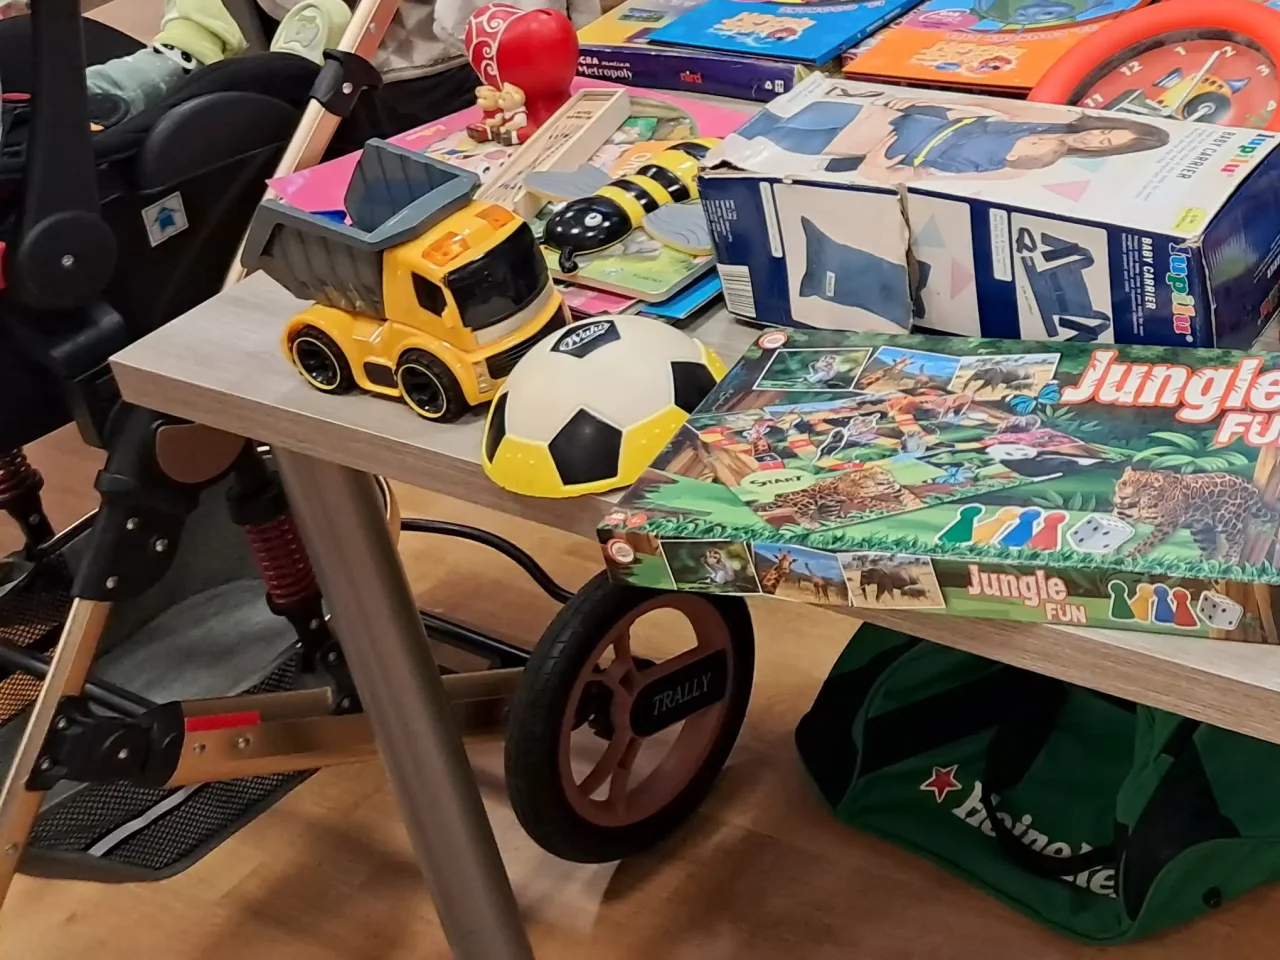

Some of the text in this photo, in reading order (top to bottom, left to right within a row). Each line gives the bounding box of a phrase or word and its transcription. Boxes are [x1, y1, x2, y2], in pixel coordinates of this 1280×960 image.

[577, 55, 599, 66] GRA
[1174, 46, 1187, 56] 1
[1221, 45, 1237, 58] 2
[577, 65, 632, 80] Metropoly
[1120, 61, 1143, 77] 12
[1256, 64, 1270, 77] 3
[1084, 93, 1104, 108] 11
[1175, 146, 1215, 180] CARRIER
[1220, 132, 1276, 176] lupilu
[1141, 237, 1157, 310] BABY CARRIER
[1166, 242, 1195, 335] lupilu
[966, 564, 1069, 608] Jungle
[1044, 601, 1088, 624] FUN
[652, 672, 712, 716] TRALLY
[951, 780, 1118, 899] Heinee
